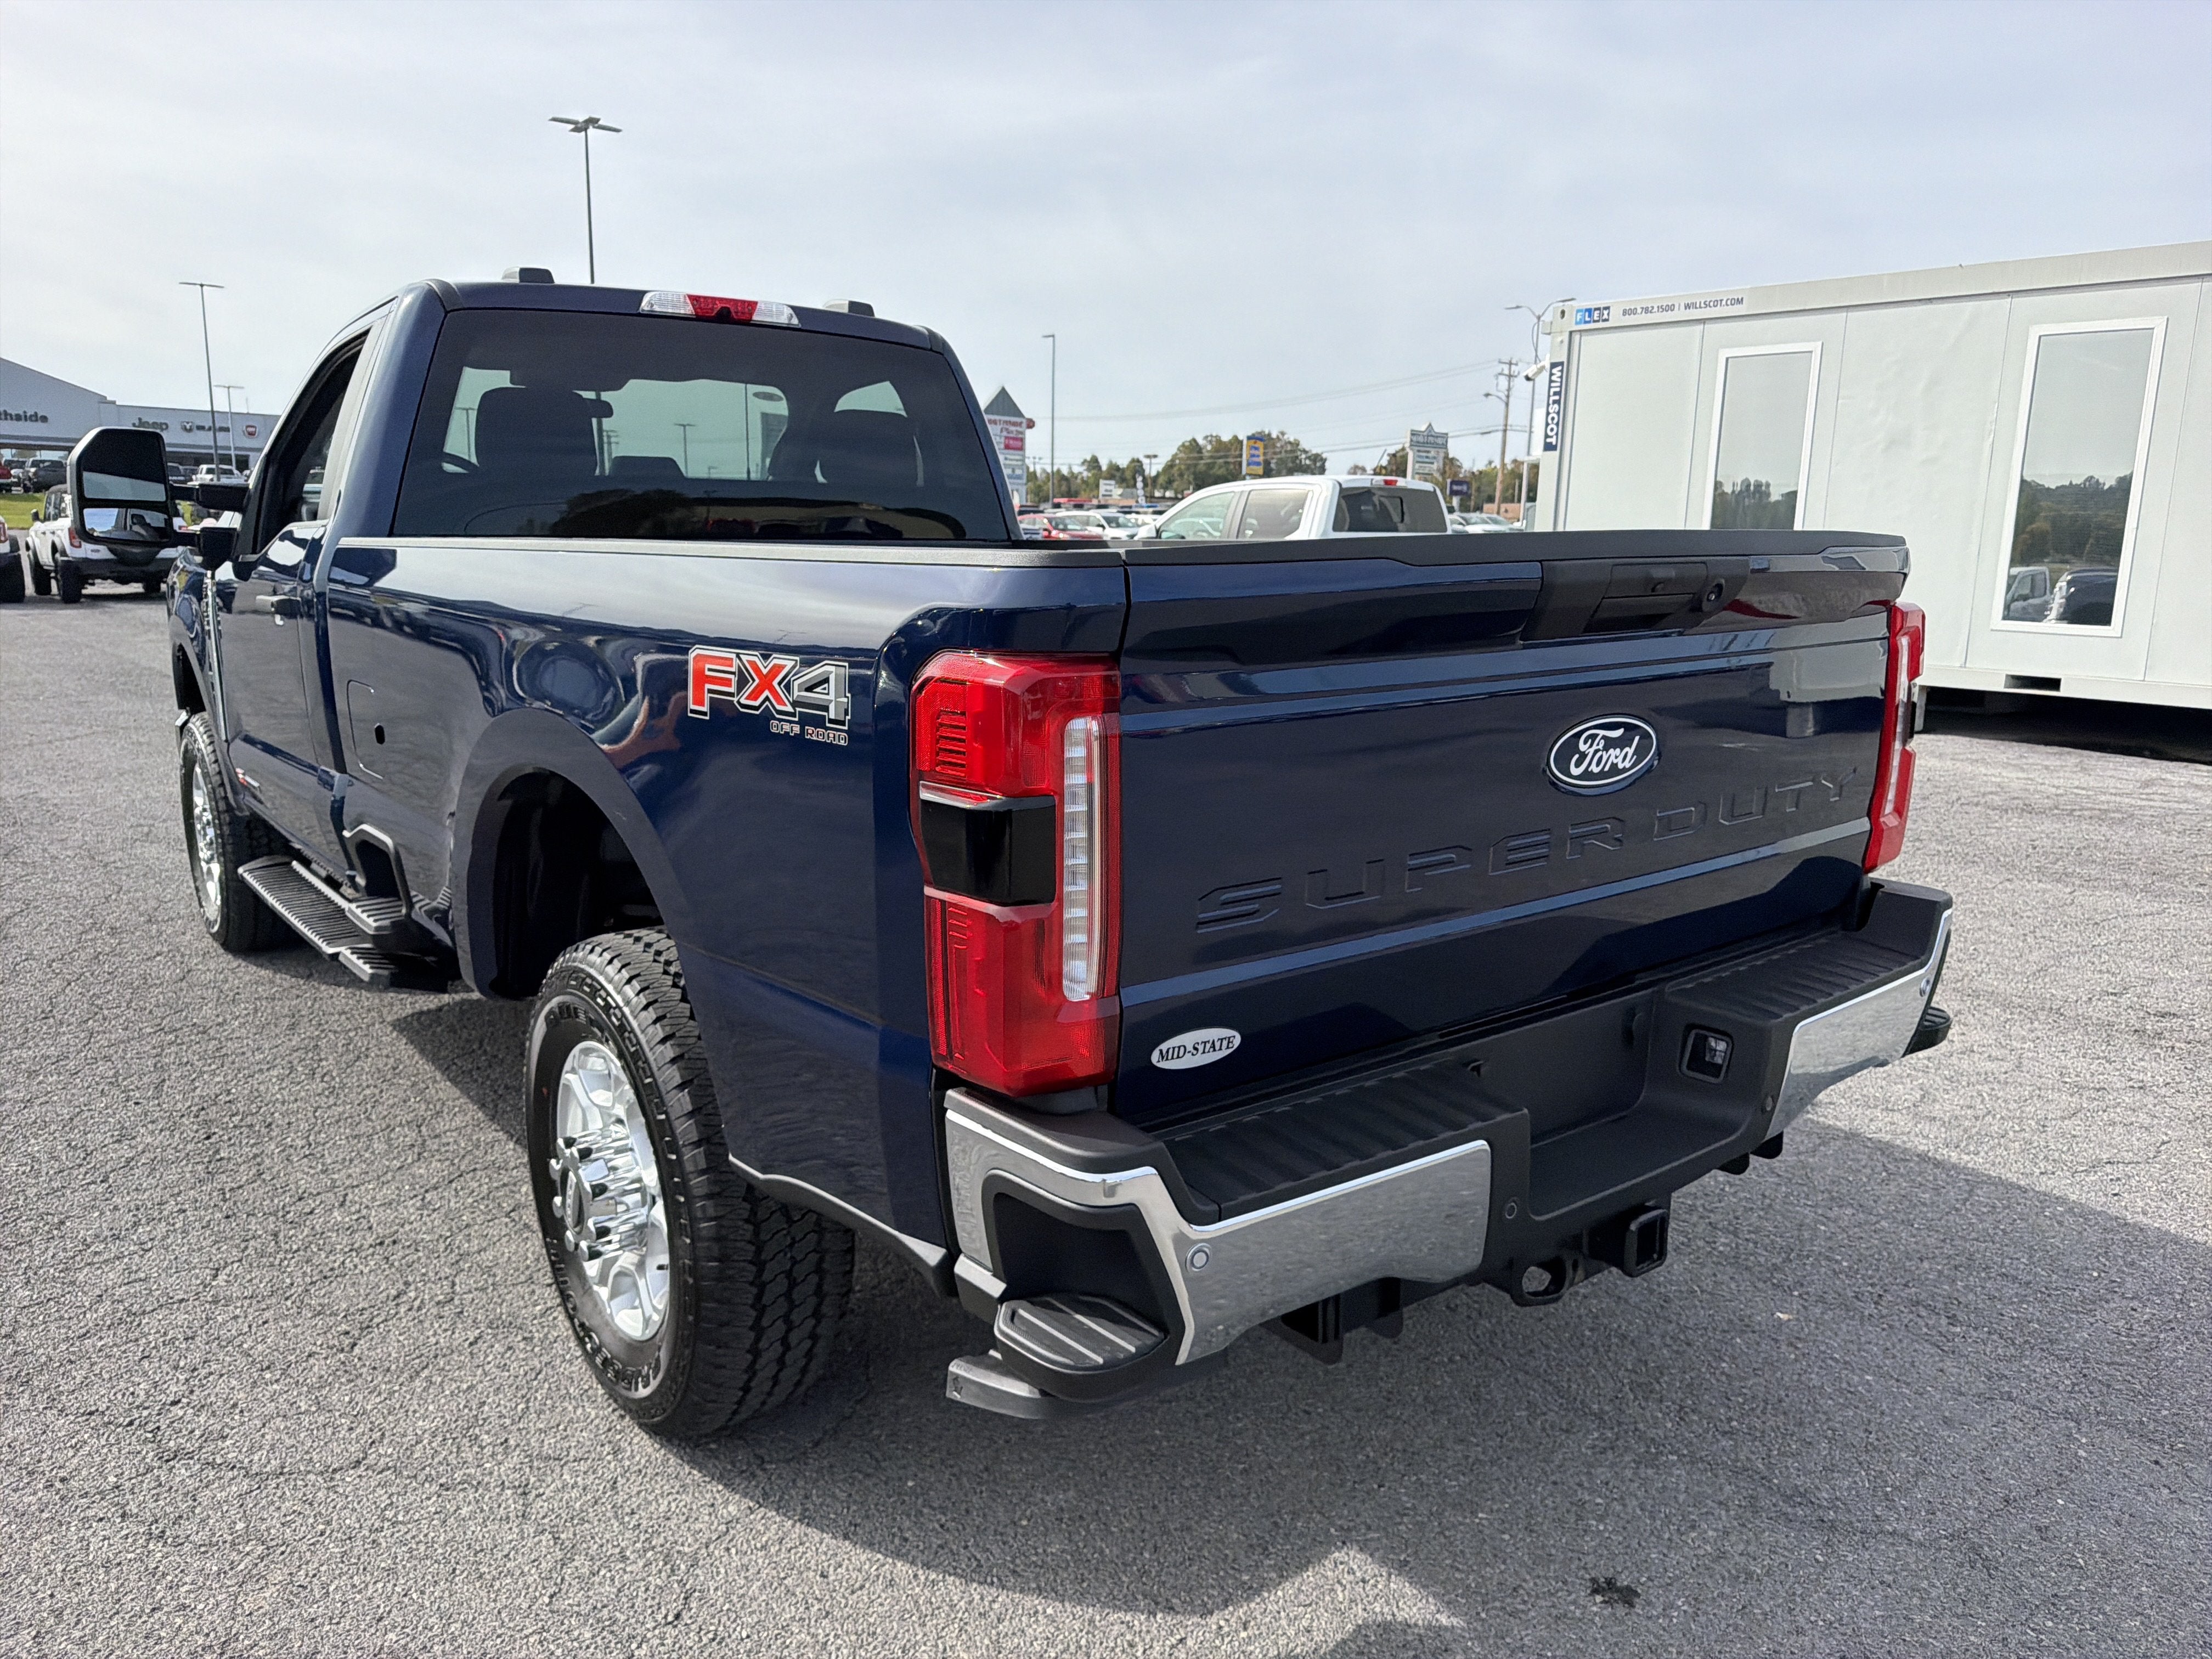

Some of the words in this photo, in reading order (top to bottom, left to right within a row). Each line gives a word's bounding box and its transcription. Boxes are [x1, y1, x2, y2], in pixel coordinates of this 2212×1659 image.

[1576, 308, 1610, 324] FLEX
[1622, 303, 1675, 317] 800.782.1500
[1684, 297, 1744, 311] WILLSCOT.COM
[1546, 365, 1562, 445] WILLSCOT
[688, 645, 851, 730] FX4
[770, 720, 800, 736] OFF
[804, 726, 848, 746] ROAD
[1570, 727, 1640, 776] Ford
[1196, 816, 1624, 933] SUPER
[1653, 766, 1858, 841] DUTY
[1155, 1035, 1236, 1063] MID-STATE
